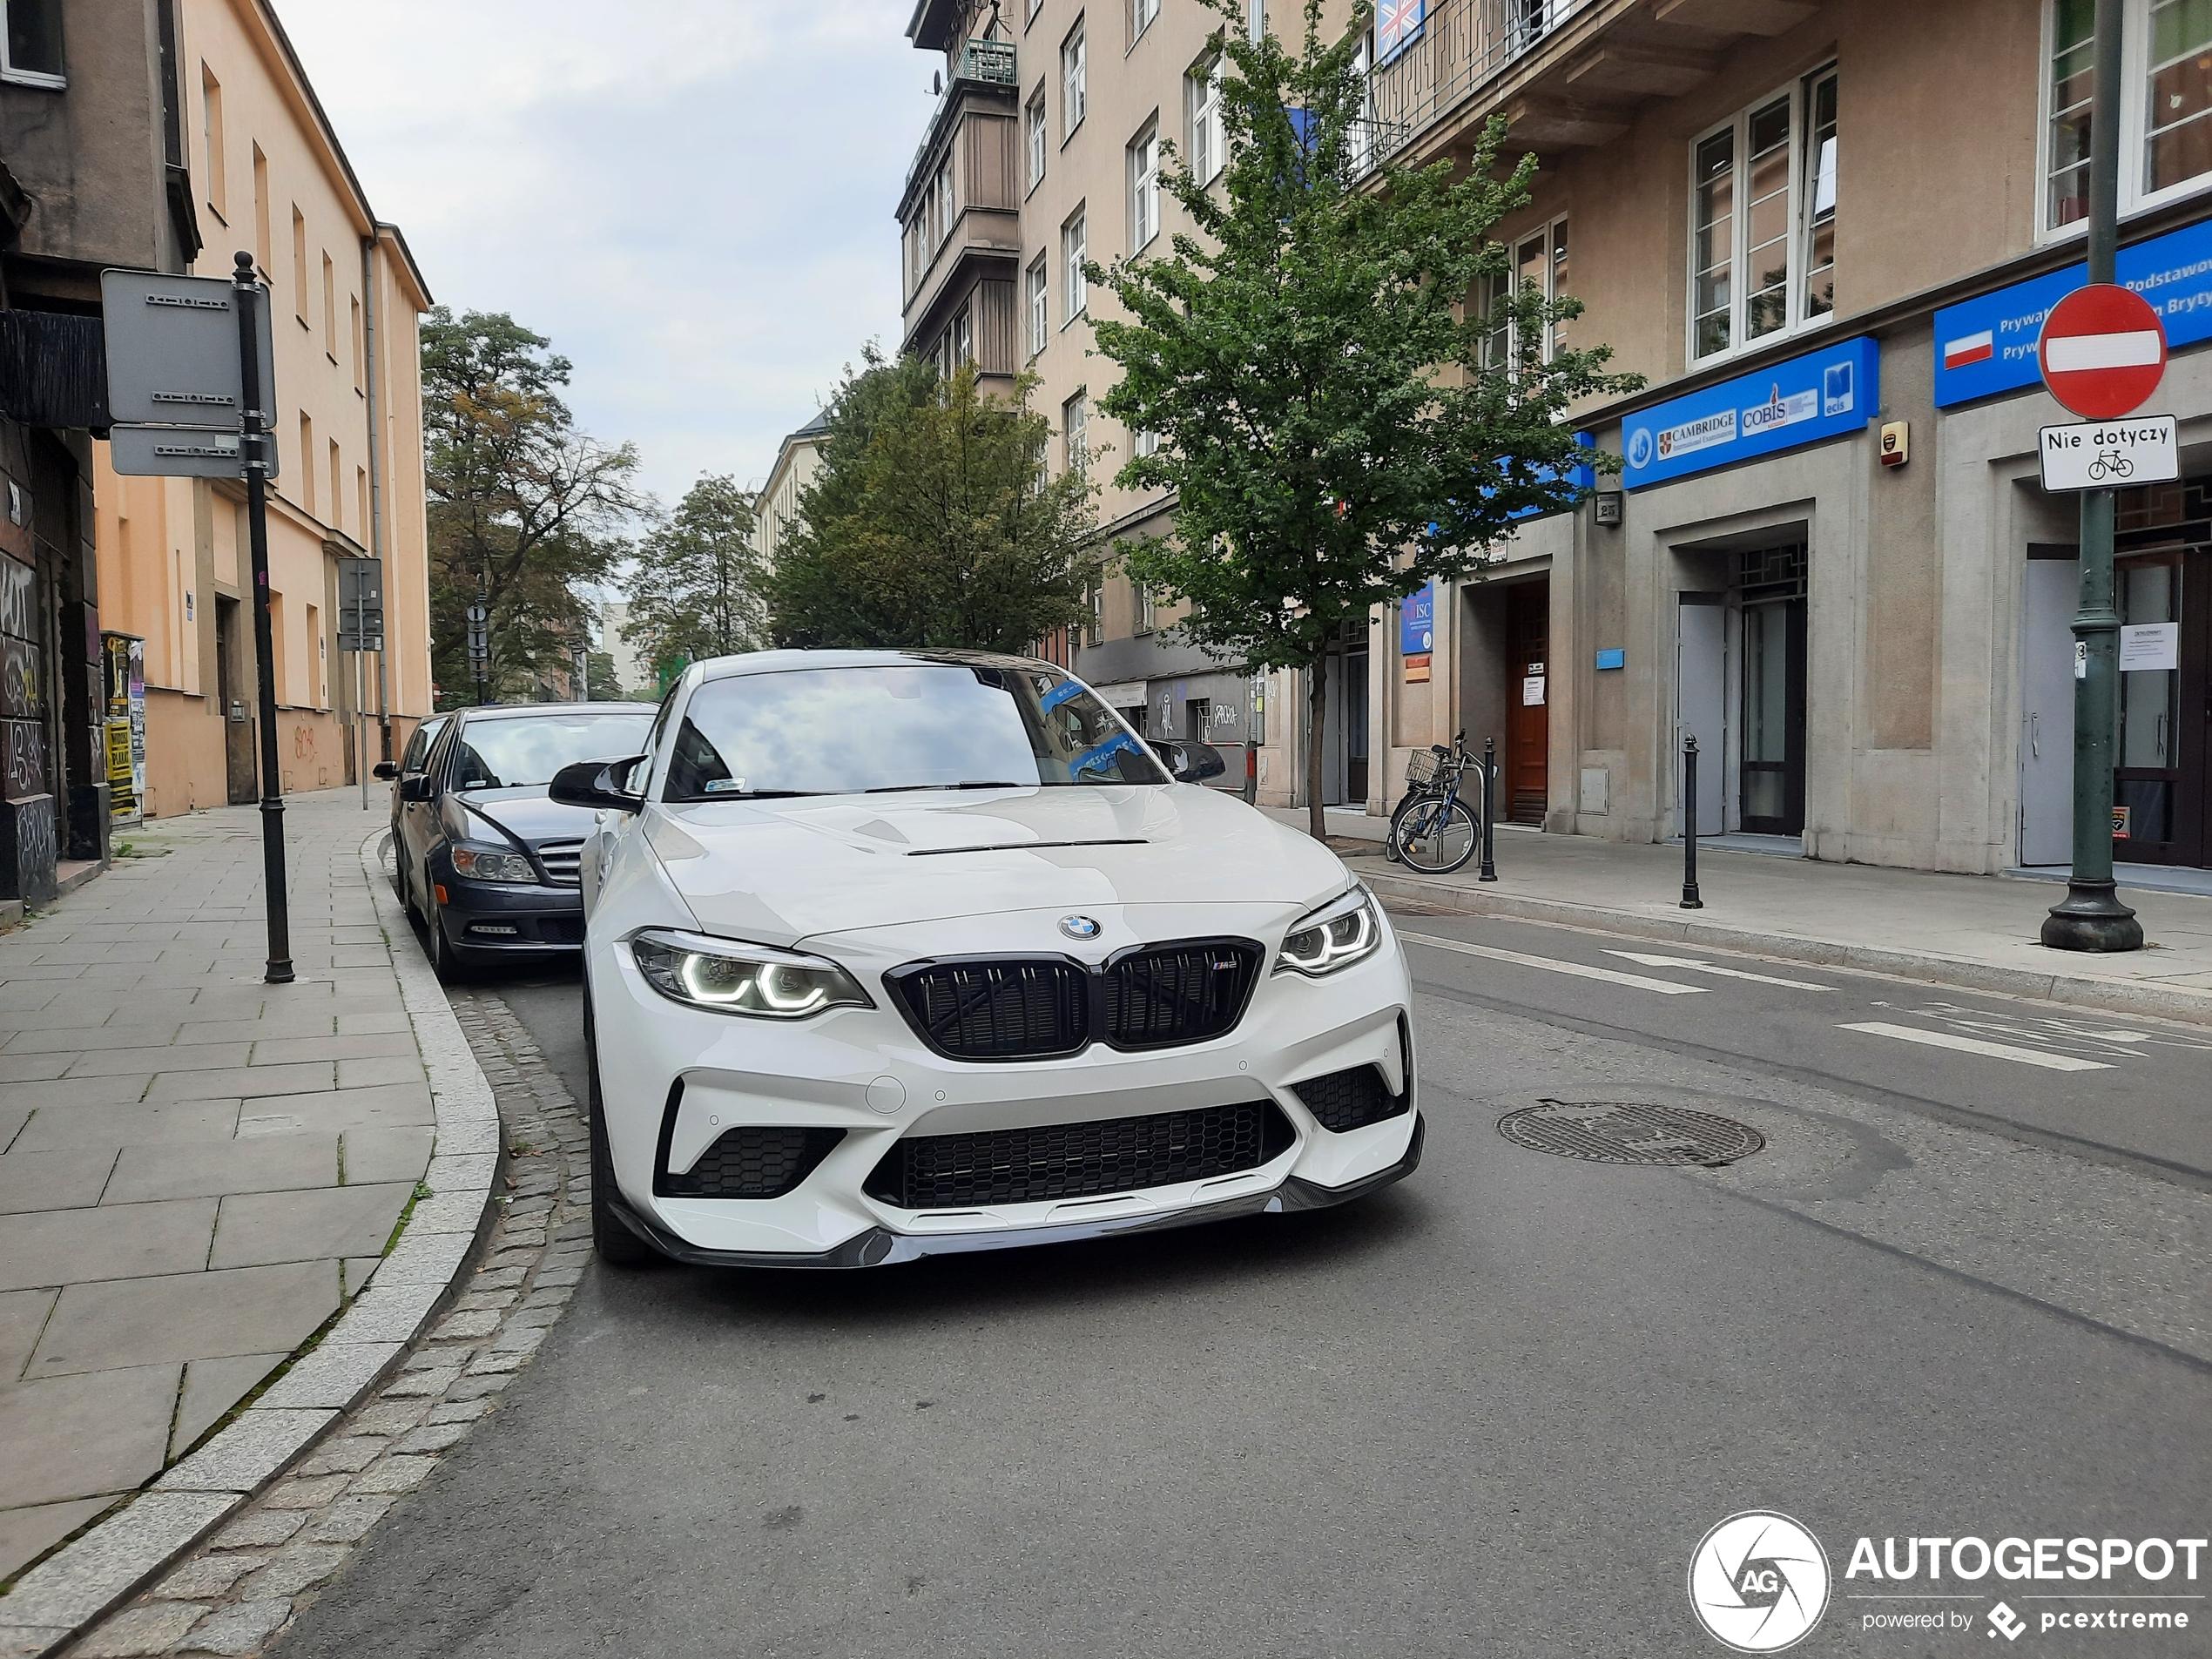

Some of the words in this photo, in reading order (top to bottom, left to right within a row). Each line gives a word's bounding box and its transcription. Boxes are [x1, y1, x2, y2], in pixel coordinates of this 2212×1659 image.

[2125, 259, 2212, 292] Podstawo
[1743, 402, 1786, 428] COBIS
[1826, 399, 1844, 415] ecis
[1672, 411, 1735, 442] CAMBRIDGE
[2047, 432, 2081, 450] Nie
[2093, 426, 2168, 448] dotyczy
[1601, 505, 1615, 516] 25
